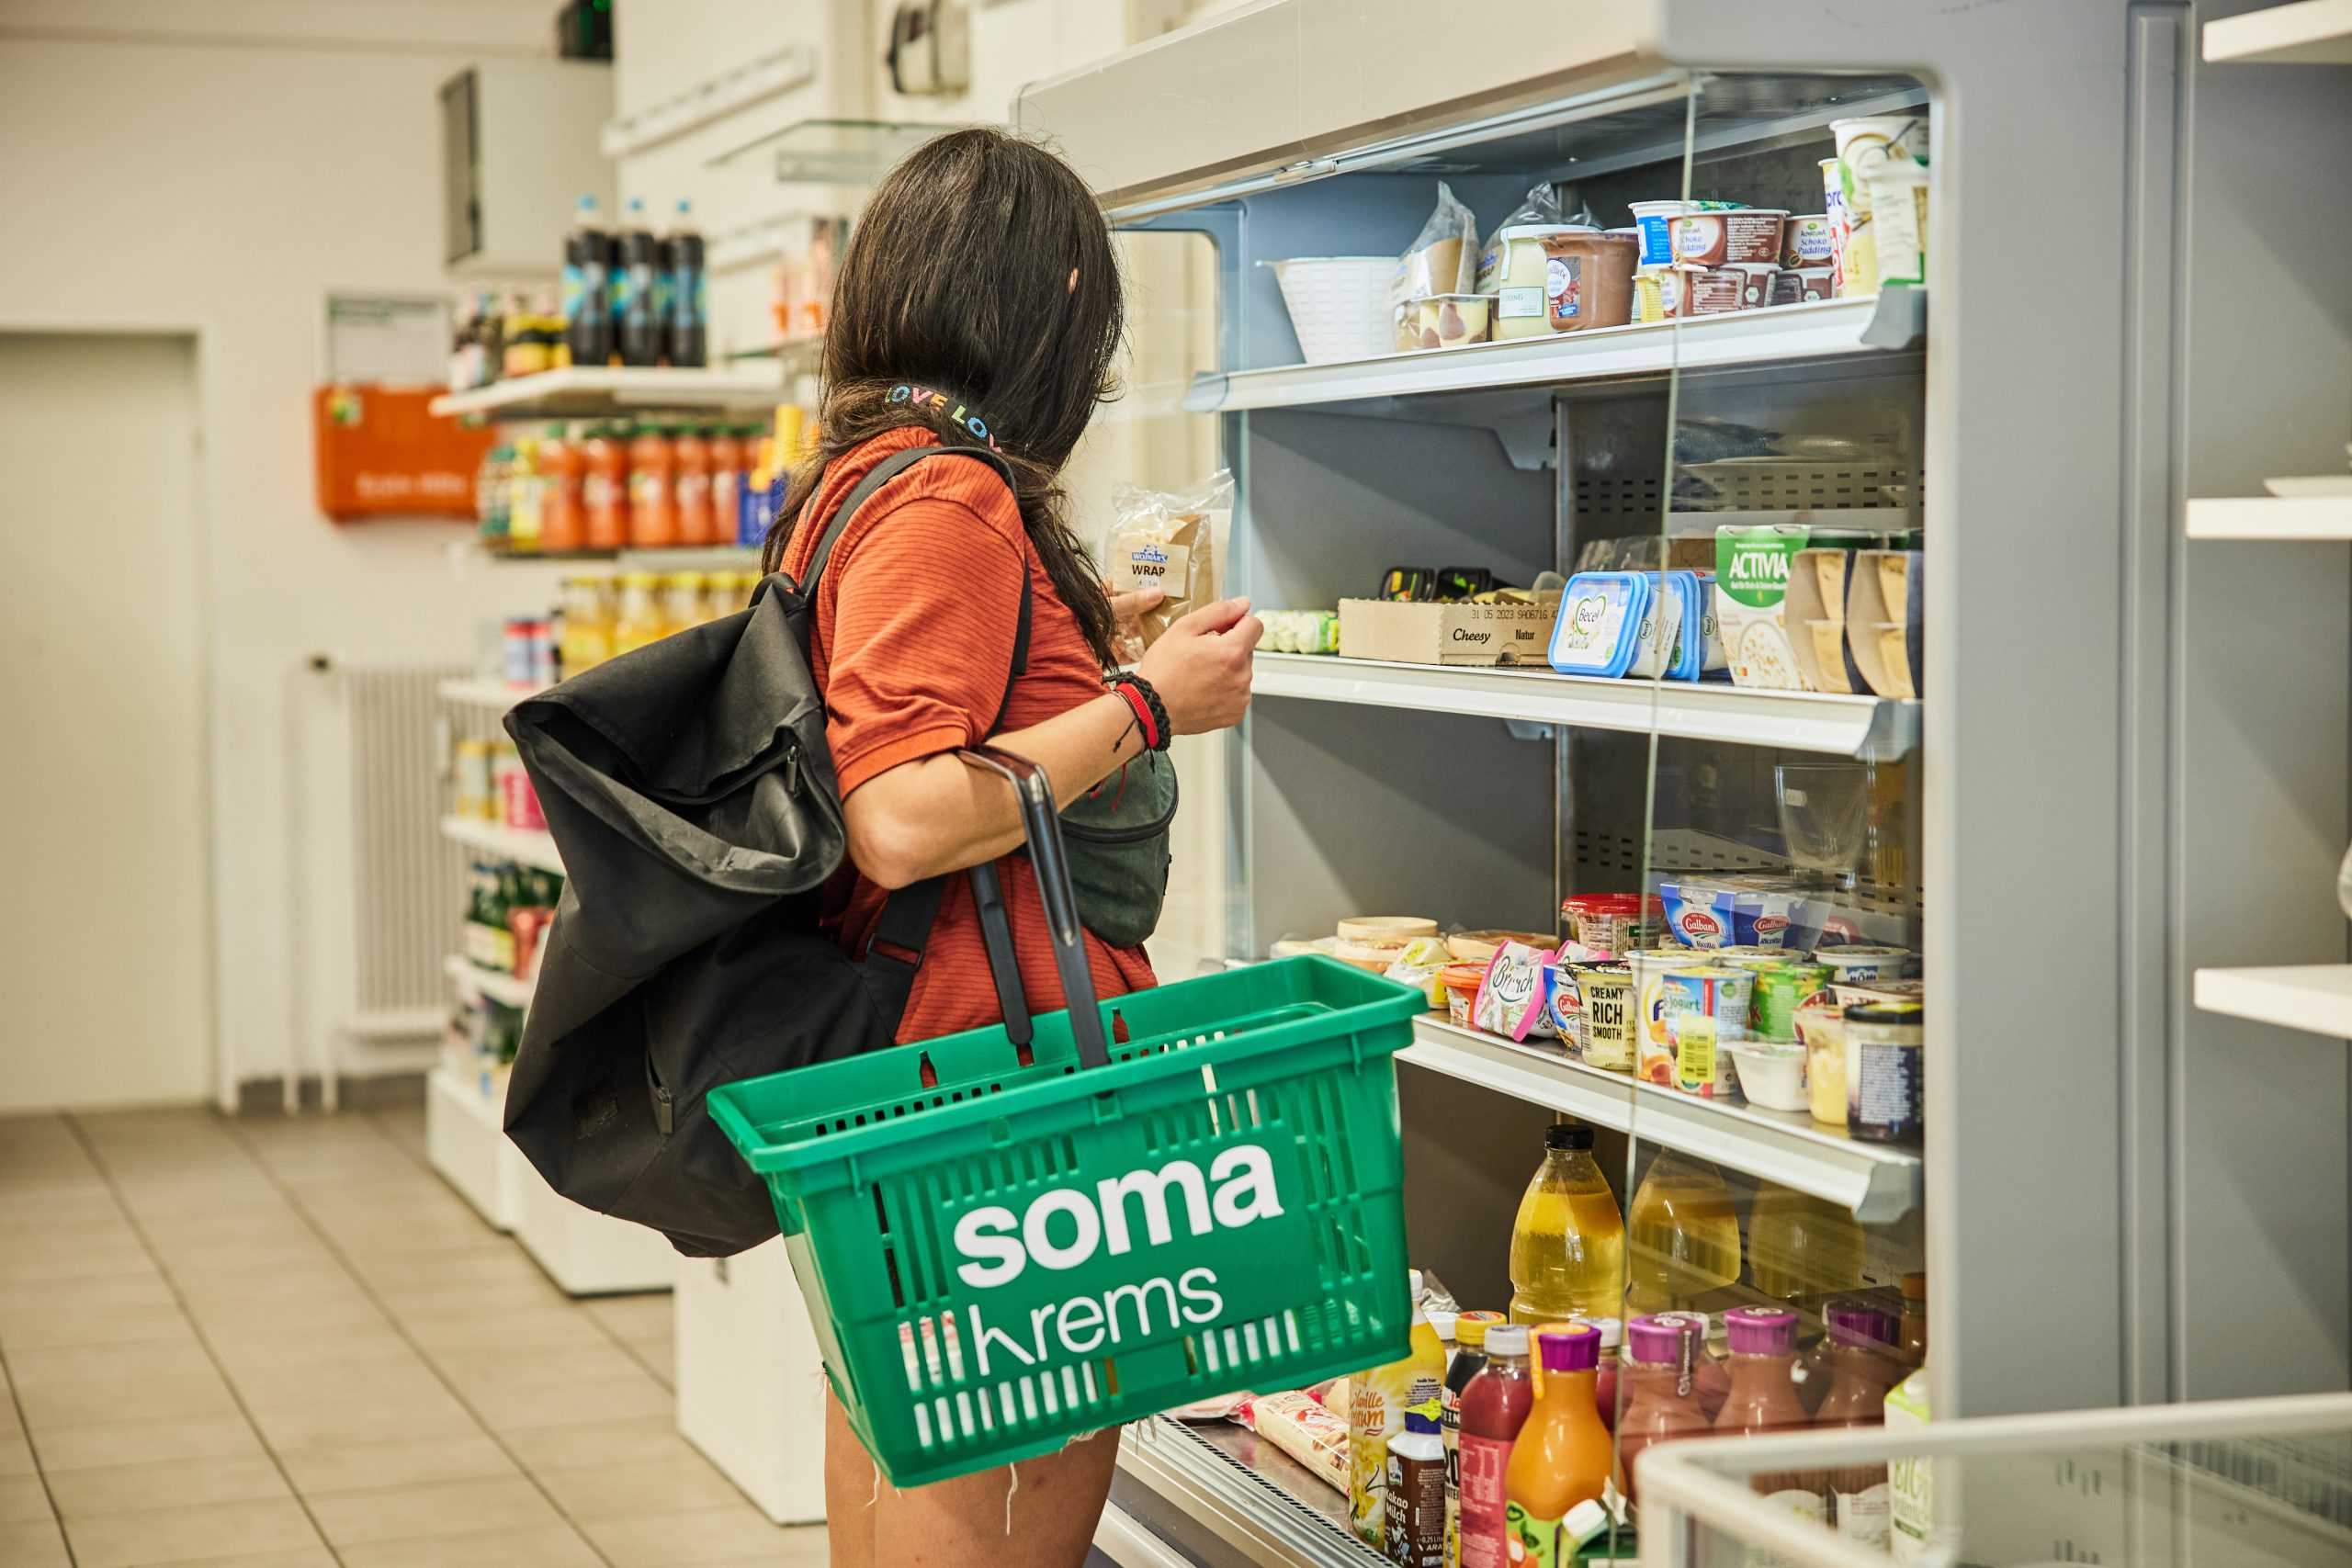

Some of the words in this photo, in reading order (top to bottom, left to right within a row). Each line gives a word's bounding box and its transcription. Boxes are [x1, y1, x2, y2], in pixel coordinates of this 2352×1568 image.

[1798, 245, 1831, 255] Pudding
[1132, 564, 1166, 577] WRAP
[1729, 552, 1789, 580] ACTIVIA
[1471, 609, 1480, 619] 31
[1484, 609, 1494, 619] 05
[1497, 609, 1515, 619] 2023
[1578, 607, 1600, 623] Becel
[1453, 628, 1491, 645] Cheesy
[1515, 629, 1535, 640] Natur
[1684, 918, 1716, 932] Galbani
[1758, 919, 1788, 930] Galbani
[1590, 986, 1624, 1000] CREAMY
[1592, 1001, 1623, 1026] RICH
[1592, 1025, 1622, 1041] SMOOTH
[954, 1145, 1285, 1288] soma
[968, 1267, 1224, 1376] krems
[1385, 1504, 1408, 1524] Milch
